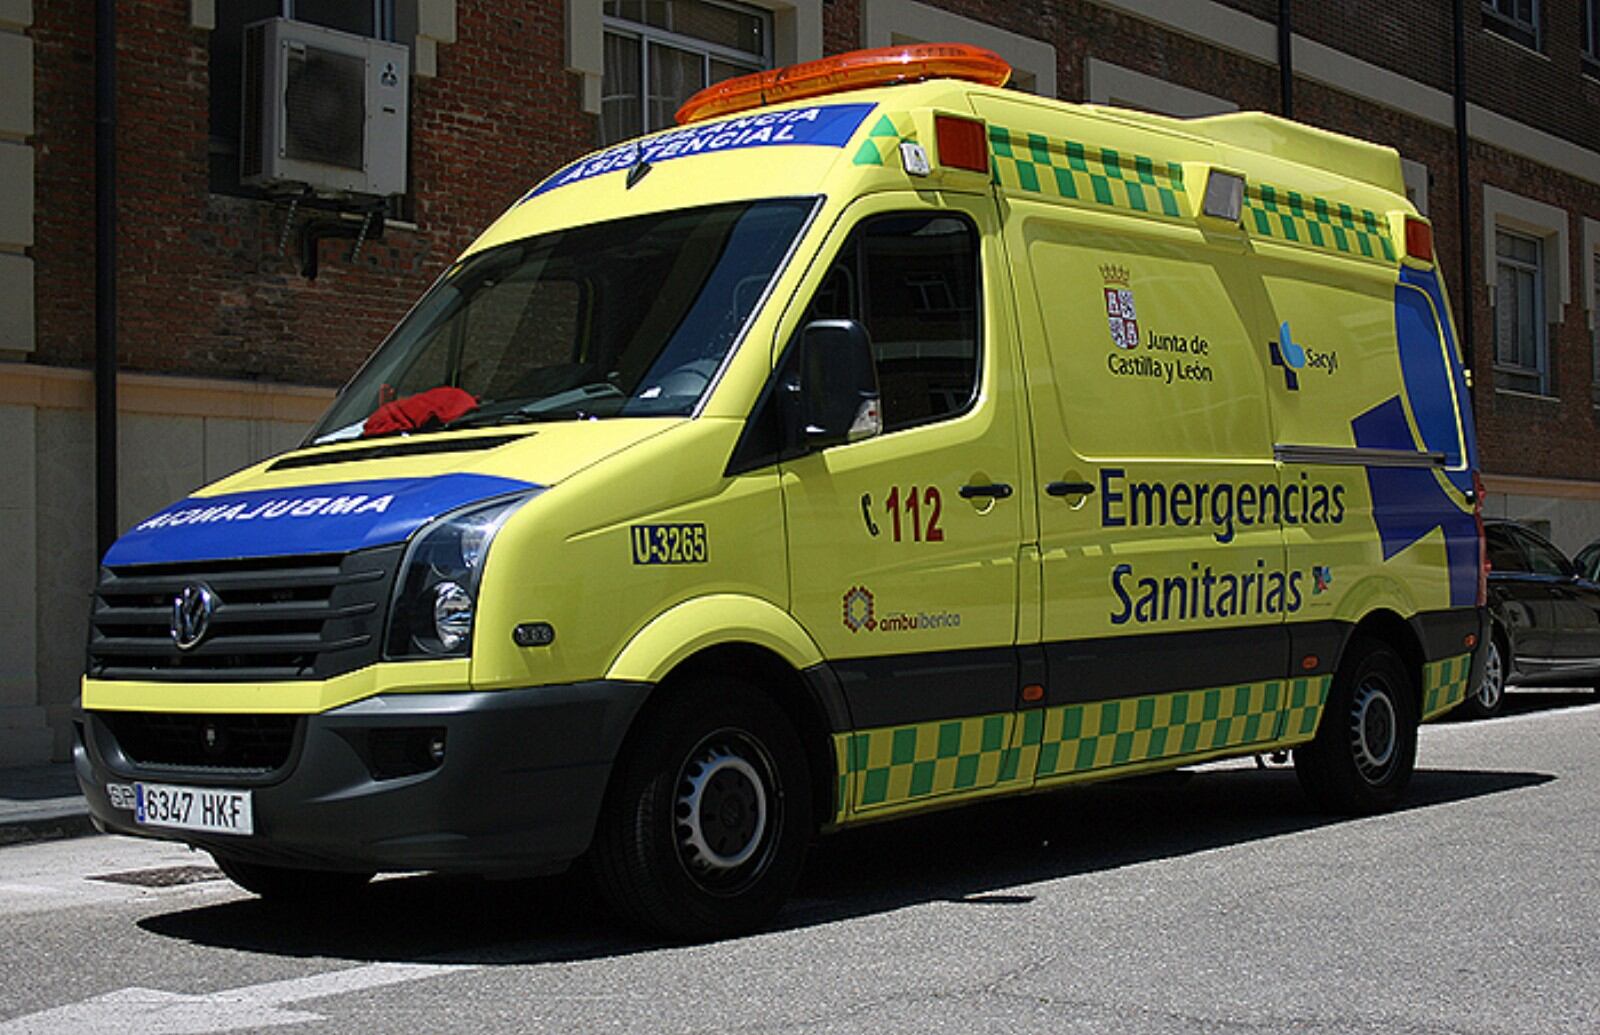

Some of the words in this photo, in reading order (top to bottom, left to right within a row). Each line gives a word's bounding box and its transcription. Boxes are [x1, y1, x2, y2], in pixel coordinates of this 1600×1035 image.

[558, 124, 795, 185] ASISTENCIAL
[1147, 330, 1187, 353] Junta
[1191, 335, 1208, 356] de
[1306, 348, 1338, 375] Sacyl
[1108, 353, 1162, 378] Castilla
[1164, 362, 1173, 384] y
[1177, 360, 1213, 382] León
[886, 485, 944, 542] 112
[1100, 468, 1345, 543] Emergencias
[635, 527, 705, 562] U-3265
[1110, 559, 1303, 625] Sanitarias
[147, 790, 193, 823] 6347
[202, 794, 243, 828] HKF
